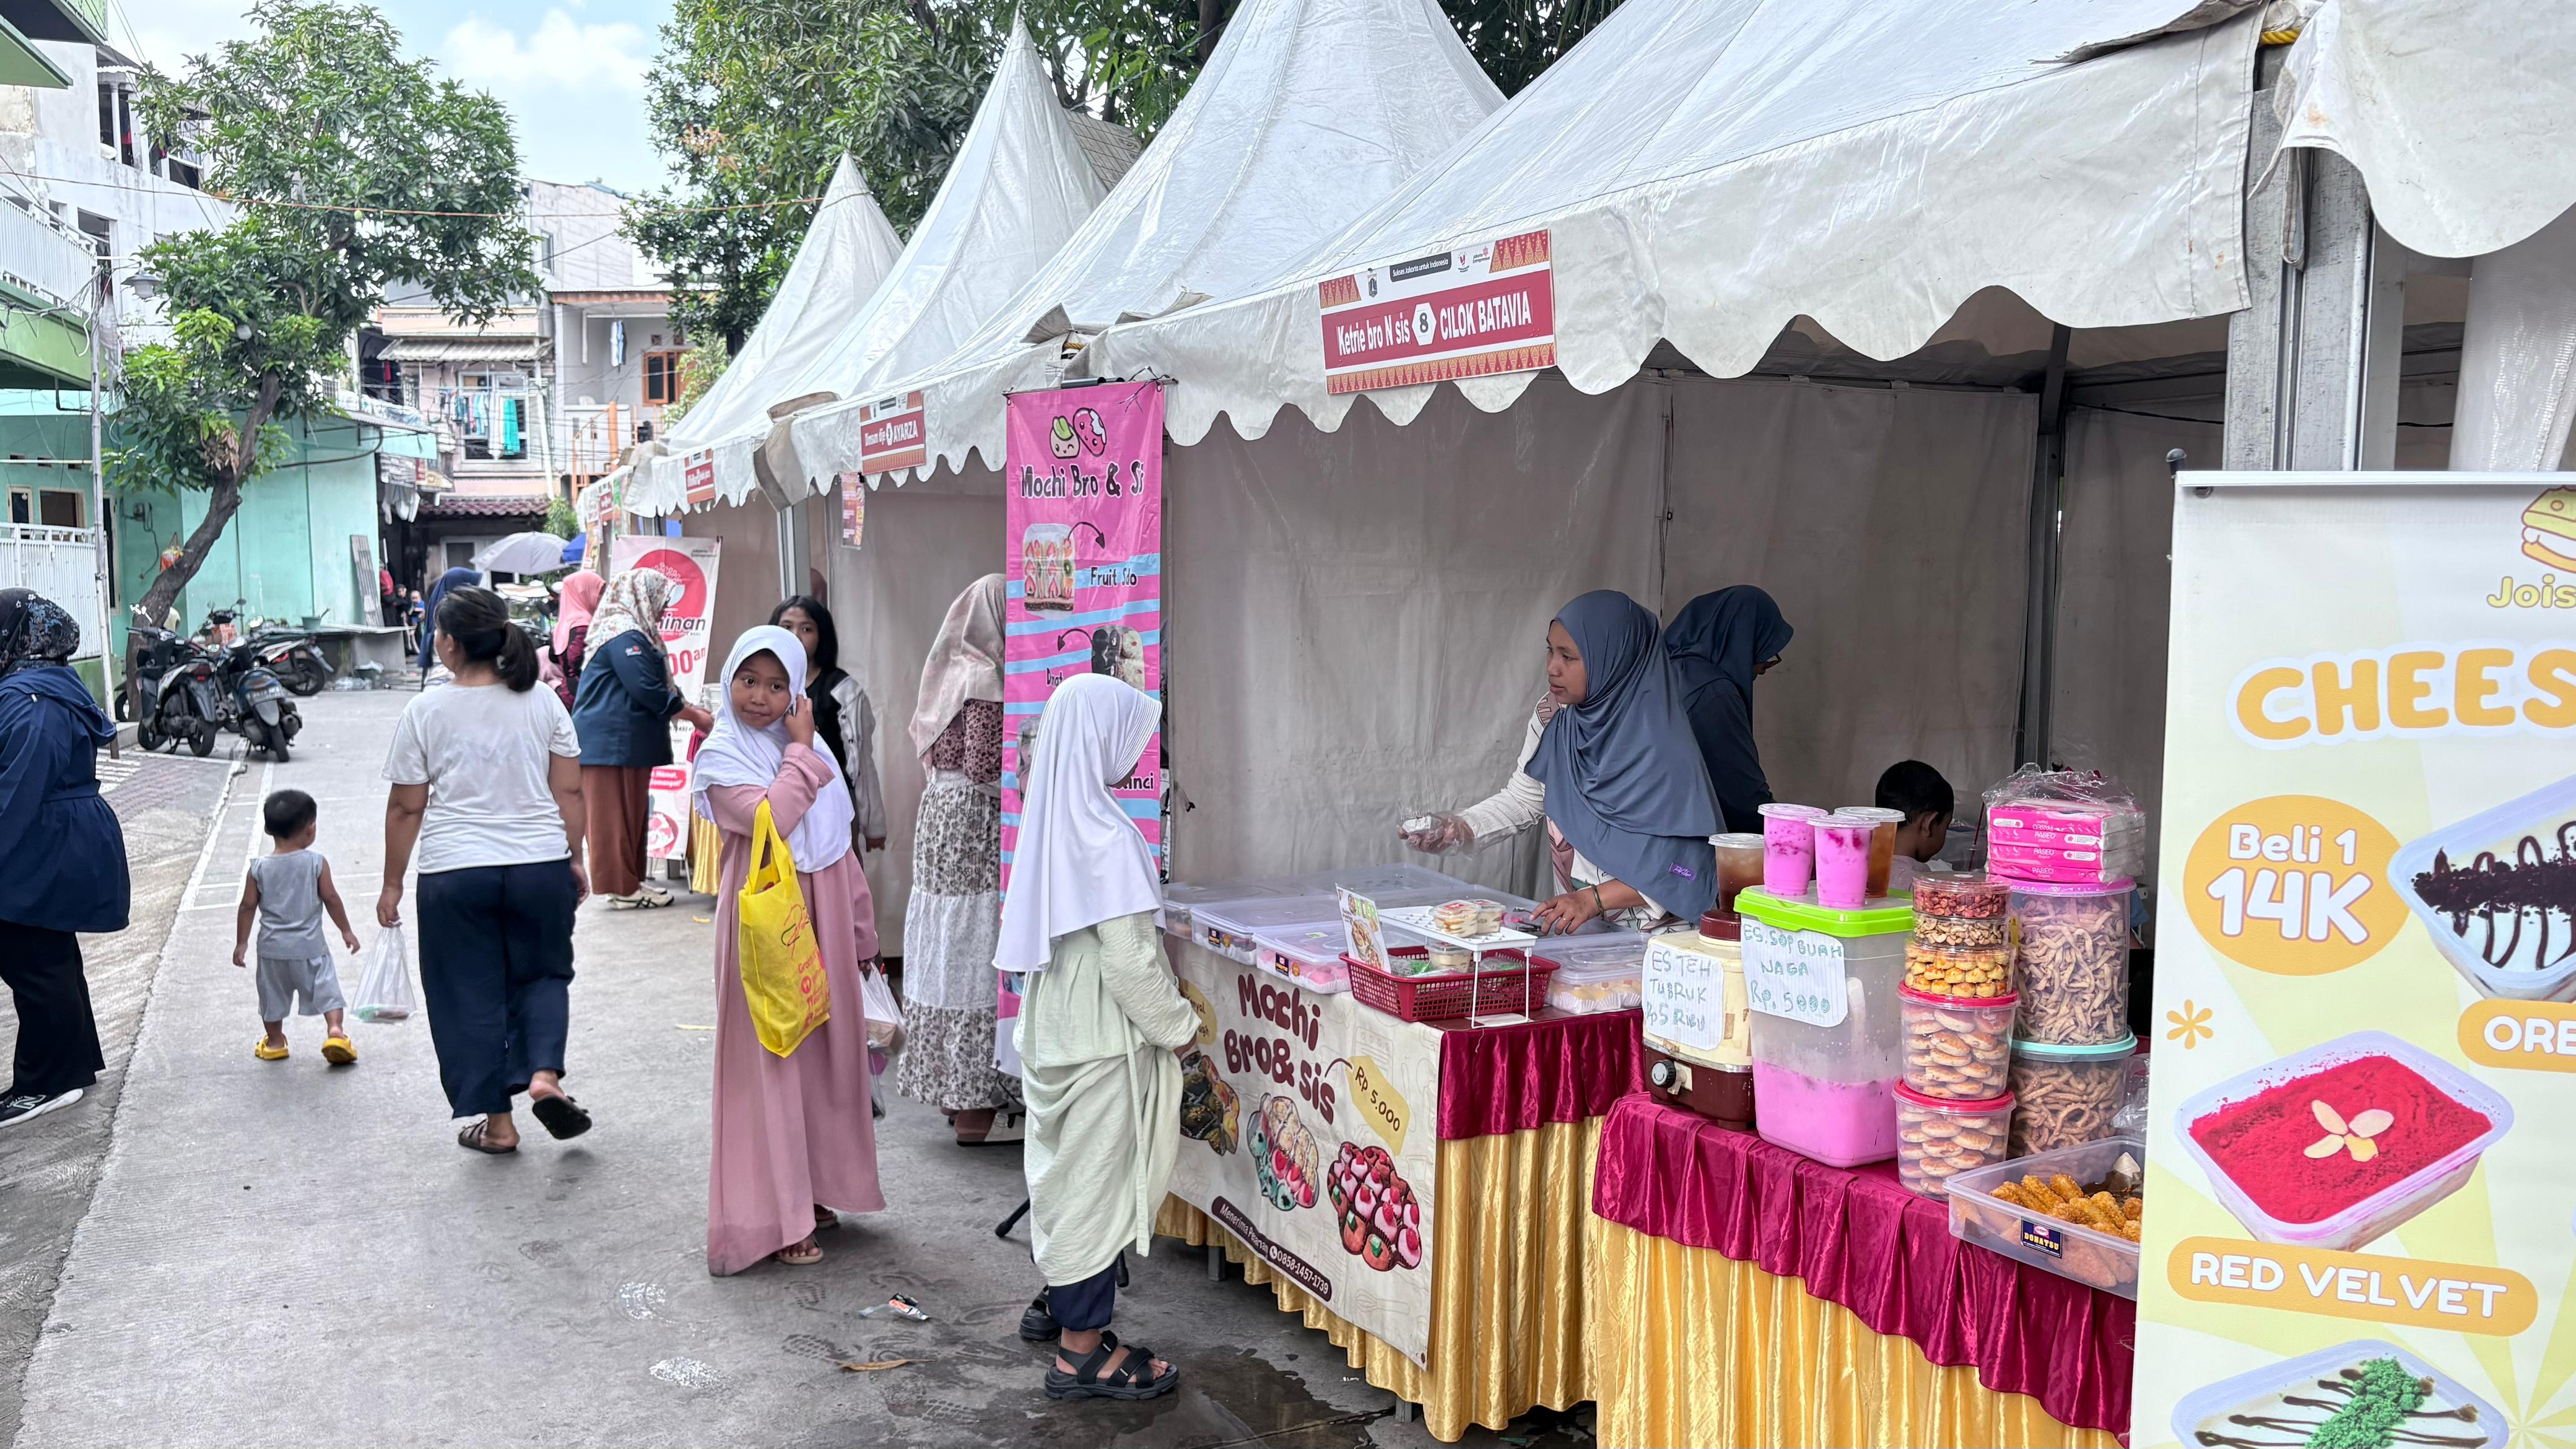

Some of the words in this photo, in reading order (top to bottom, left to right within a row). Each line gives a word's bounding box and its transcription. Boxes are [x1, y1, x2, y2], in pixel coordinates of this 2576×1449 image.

[1430, 258, 1448, 269] Indonesia
[1337, 322, 1366, 356] Ketrie
[1367, 320, 1384, 350] bro
[1385, 315, 1393, 346] N
[1396, 311, 1410, 344] sis
[1419, 312, 1429, 333] 8
[1440, 302, 1475, 340] CILOK
[1478, 290, 1533, 333] BATAVIA
[893, 420, 918, 443] AYARZA
[1021, 464, 1066, 497] Mochi
[1071, 464, 1099, 497] Bro
[1106, 463, 1121, 497] &
[1090, 567, 1117, 586] Fruit
[2235, 648, 2576, 741] CHEES
[2229, 823, 2322, 864] Beli
[2334, 828, 2357, 866] 1
[2206, 866, 2374, 946] 14K
[1676, 955, 1712, 977] TEH
[1760, 960, 1809, 976] NAGA
[1798, 939, 1842, 959] BUAH
[1238, 973, 1321, 1051] Mochi
[1370, 1089, 1400, 1132] 5.000
[1219, 1204, 1248, 1235] Menerima
[1277, 1250, 1329, 1295] 0858-1457-1739
[2190, 1250, 2286, 1293] RED
[2297, 1262, 2508, 1318] VELVET
